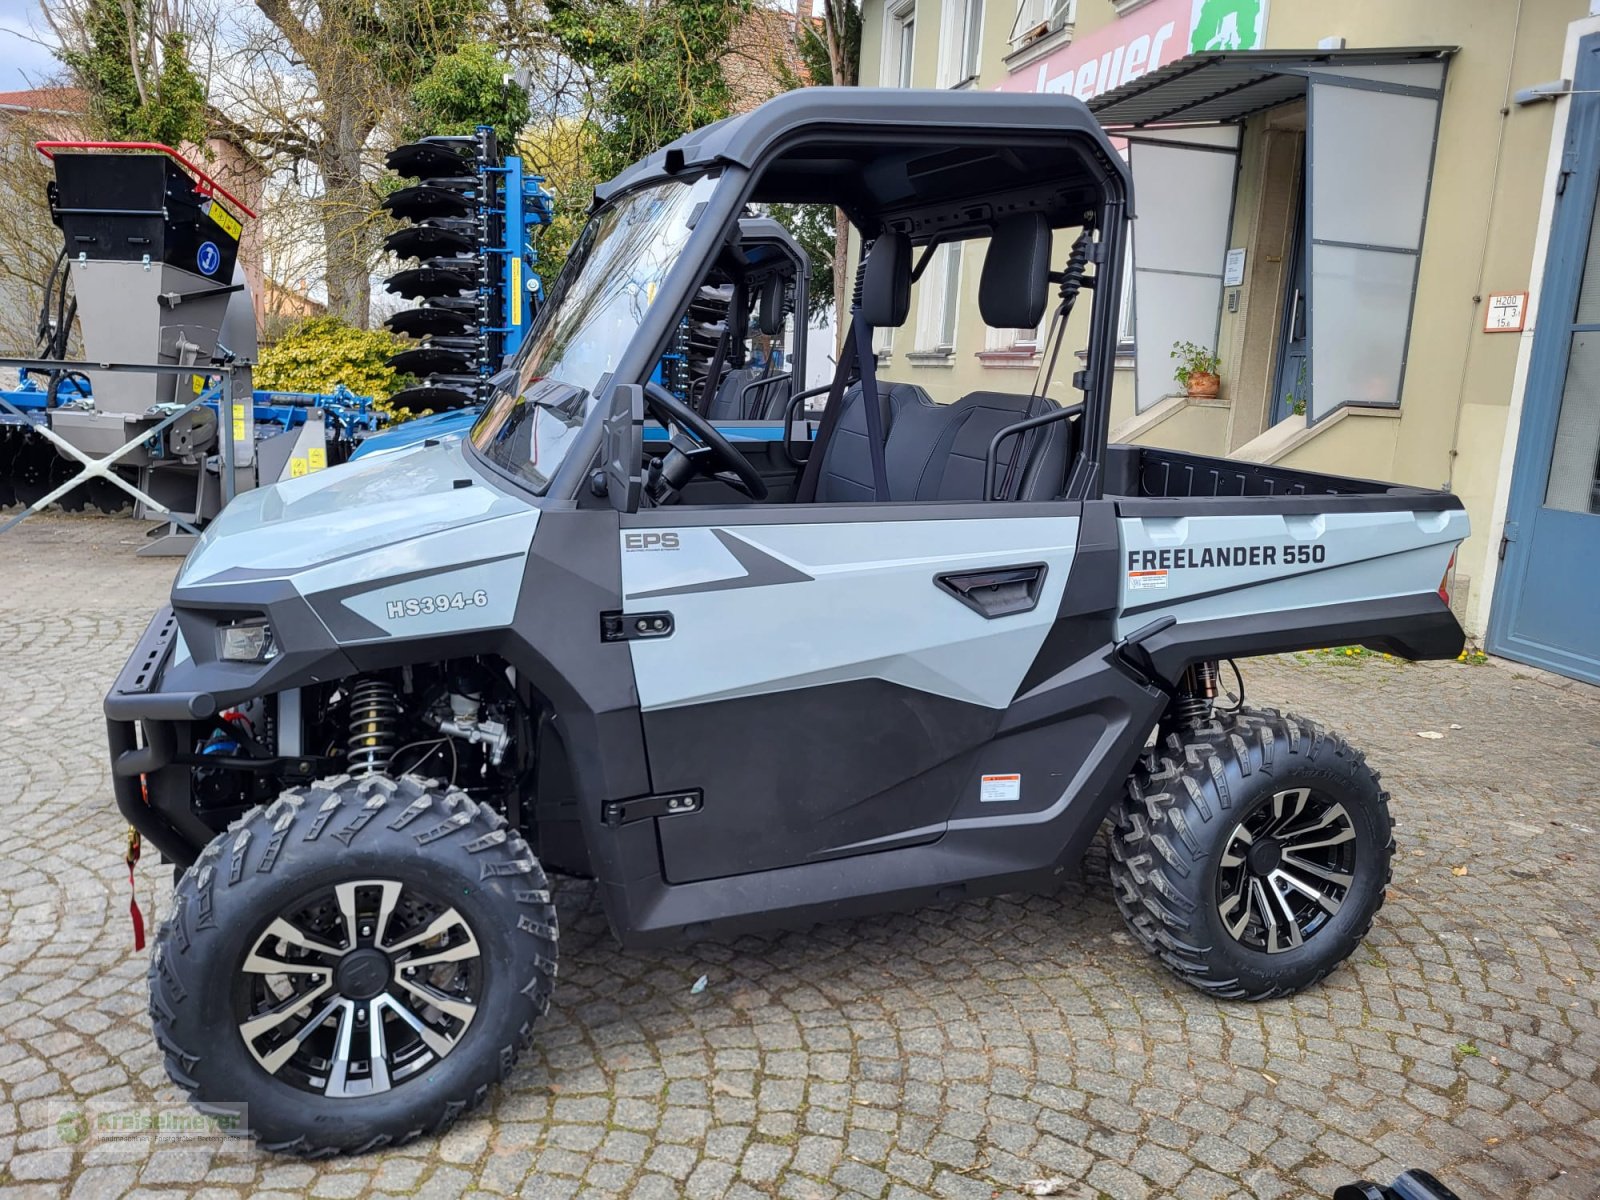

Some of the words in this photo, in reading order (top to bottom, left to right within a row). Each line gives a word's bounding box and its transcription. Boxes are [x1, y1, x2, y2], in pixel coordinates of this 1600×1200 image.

[1496, 295, 1517, 306] H200
[625, 533, 680, 548] EPS
[1128, 546, 1277, 570] FREELANDER
[1283, 544, 1326, 564] 550
[386, 589, 489, 619] HS394-6
